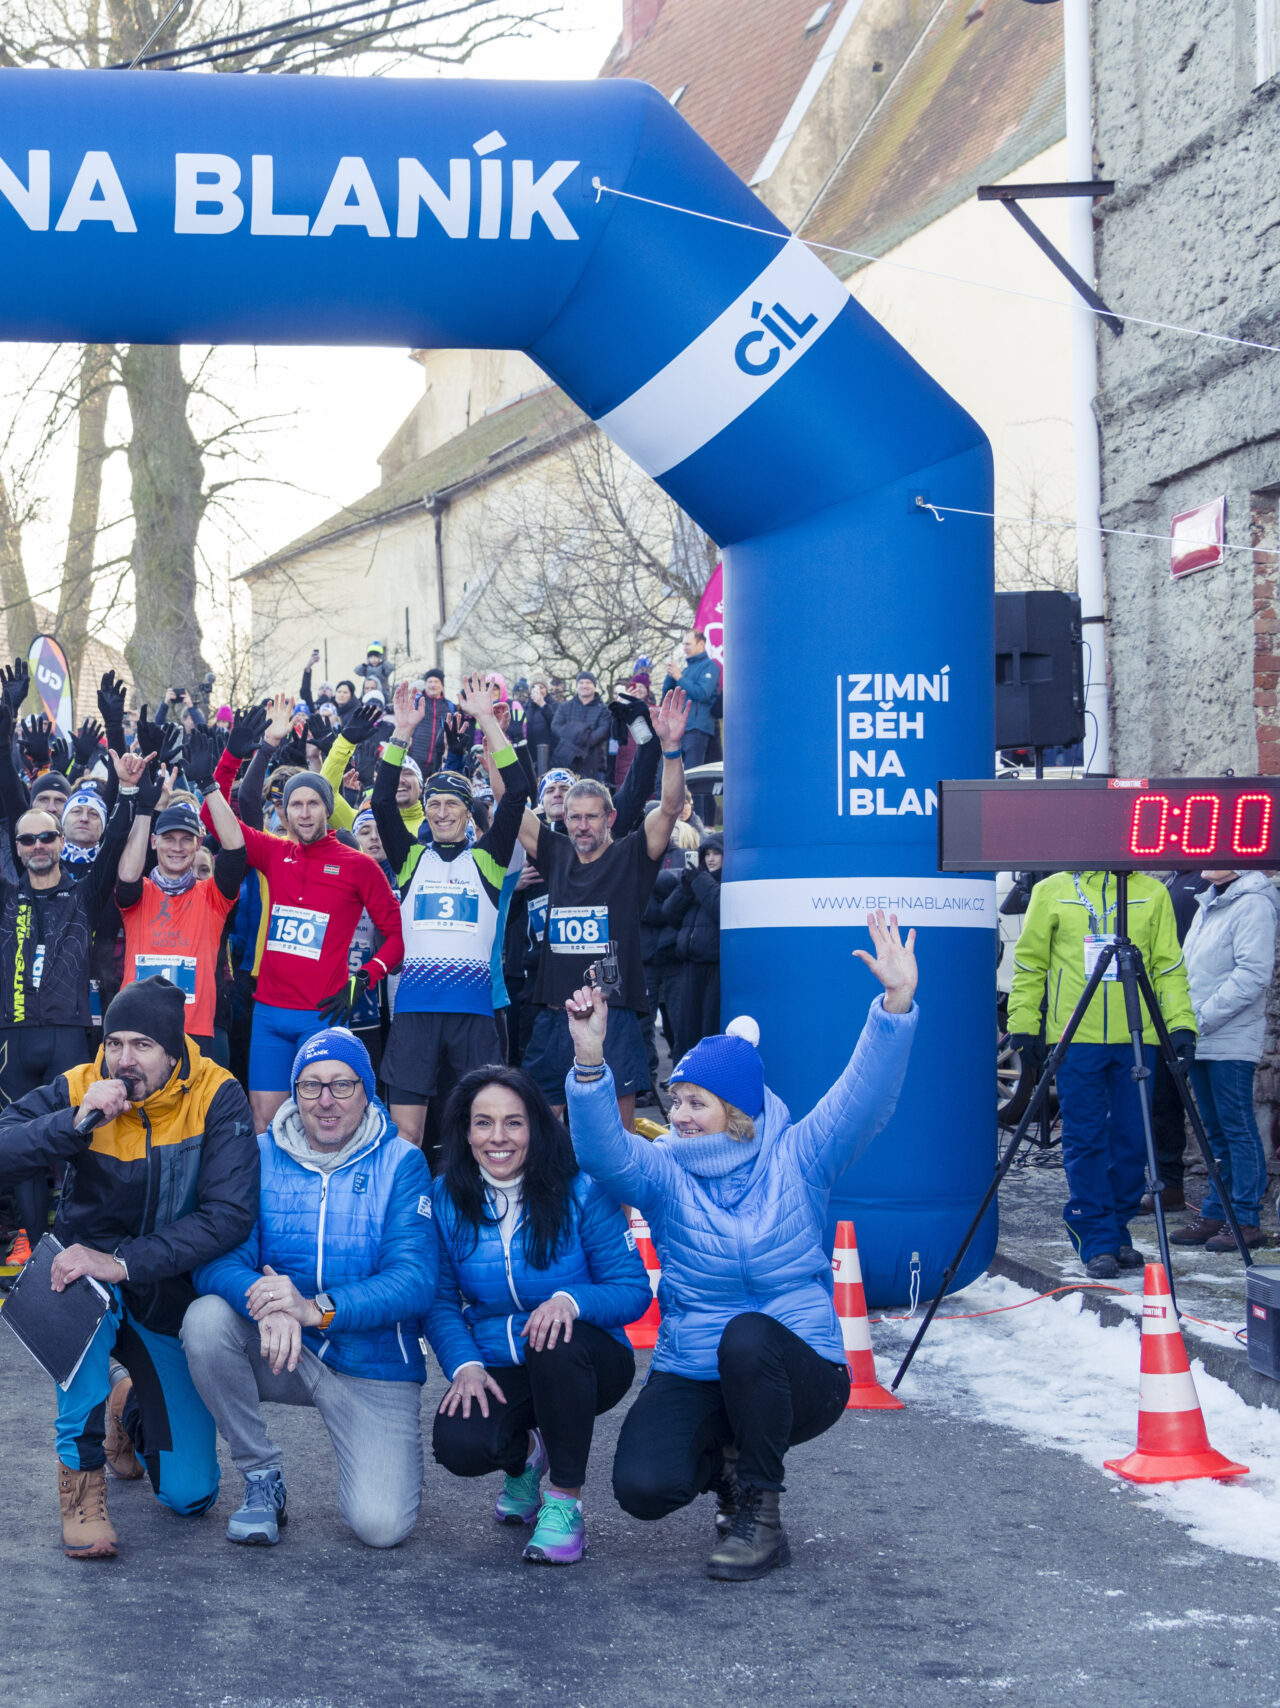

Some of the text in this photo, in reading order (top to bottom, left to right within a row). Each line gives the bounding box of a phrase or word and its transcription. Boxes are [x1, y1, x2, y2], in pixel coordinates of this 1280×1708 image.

[174, 130, 581, 240] BLANÍK
[734, 301, 819, 376] CÍL
[847, 665, 951, 702] ZIMNÍ
[848, 702, 925, 739] BĚH
[849, 751, 906, 777] NA
[1131, 795, 1272, 854] 0:00
[438, 896, 454, 918] 3
[811, 895, 986, 911] WWW.BEHNABLANIK.CZ
[275, 918, 316, 944] 150
[557, 919, 600, 942] 108
